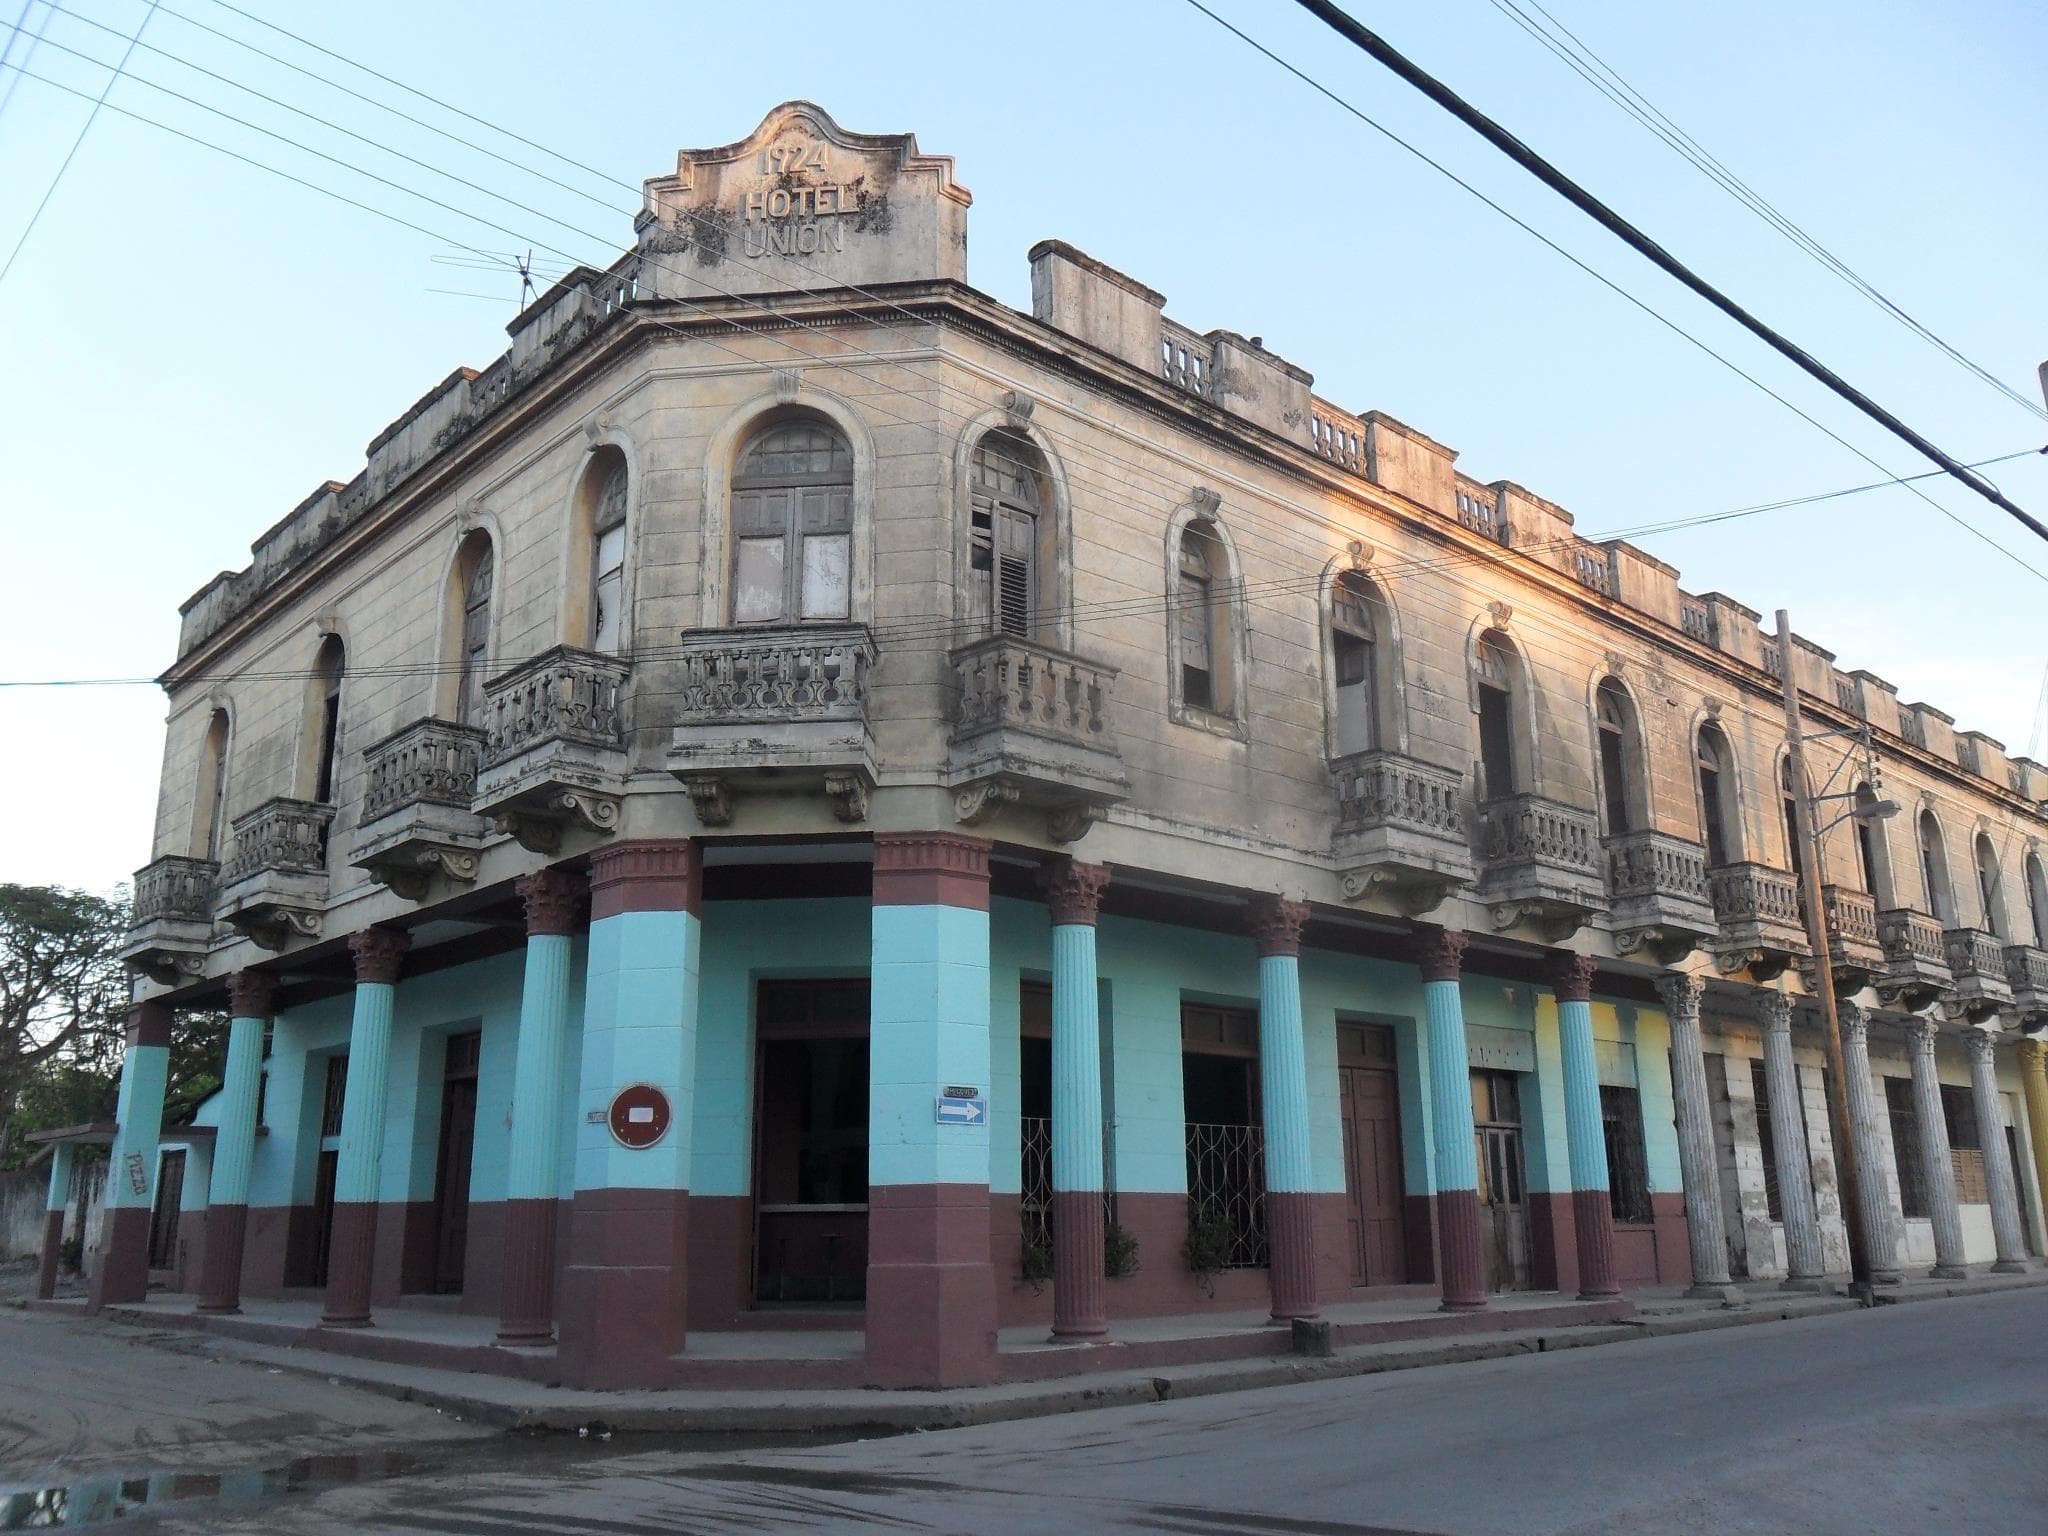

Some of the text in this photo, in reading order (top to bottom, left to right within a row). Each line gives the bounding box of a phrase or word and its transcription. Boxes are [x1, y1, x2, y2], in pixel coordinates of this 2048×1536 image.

[760, 142, 828, 175] 1924
[744, 186, 859, 221] HOTEL
[743, 221, 844, 258] UNION
